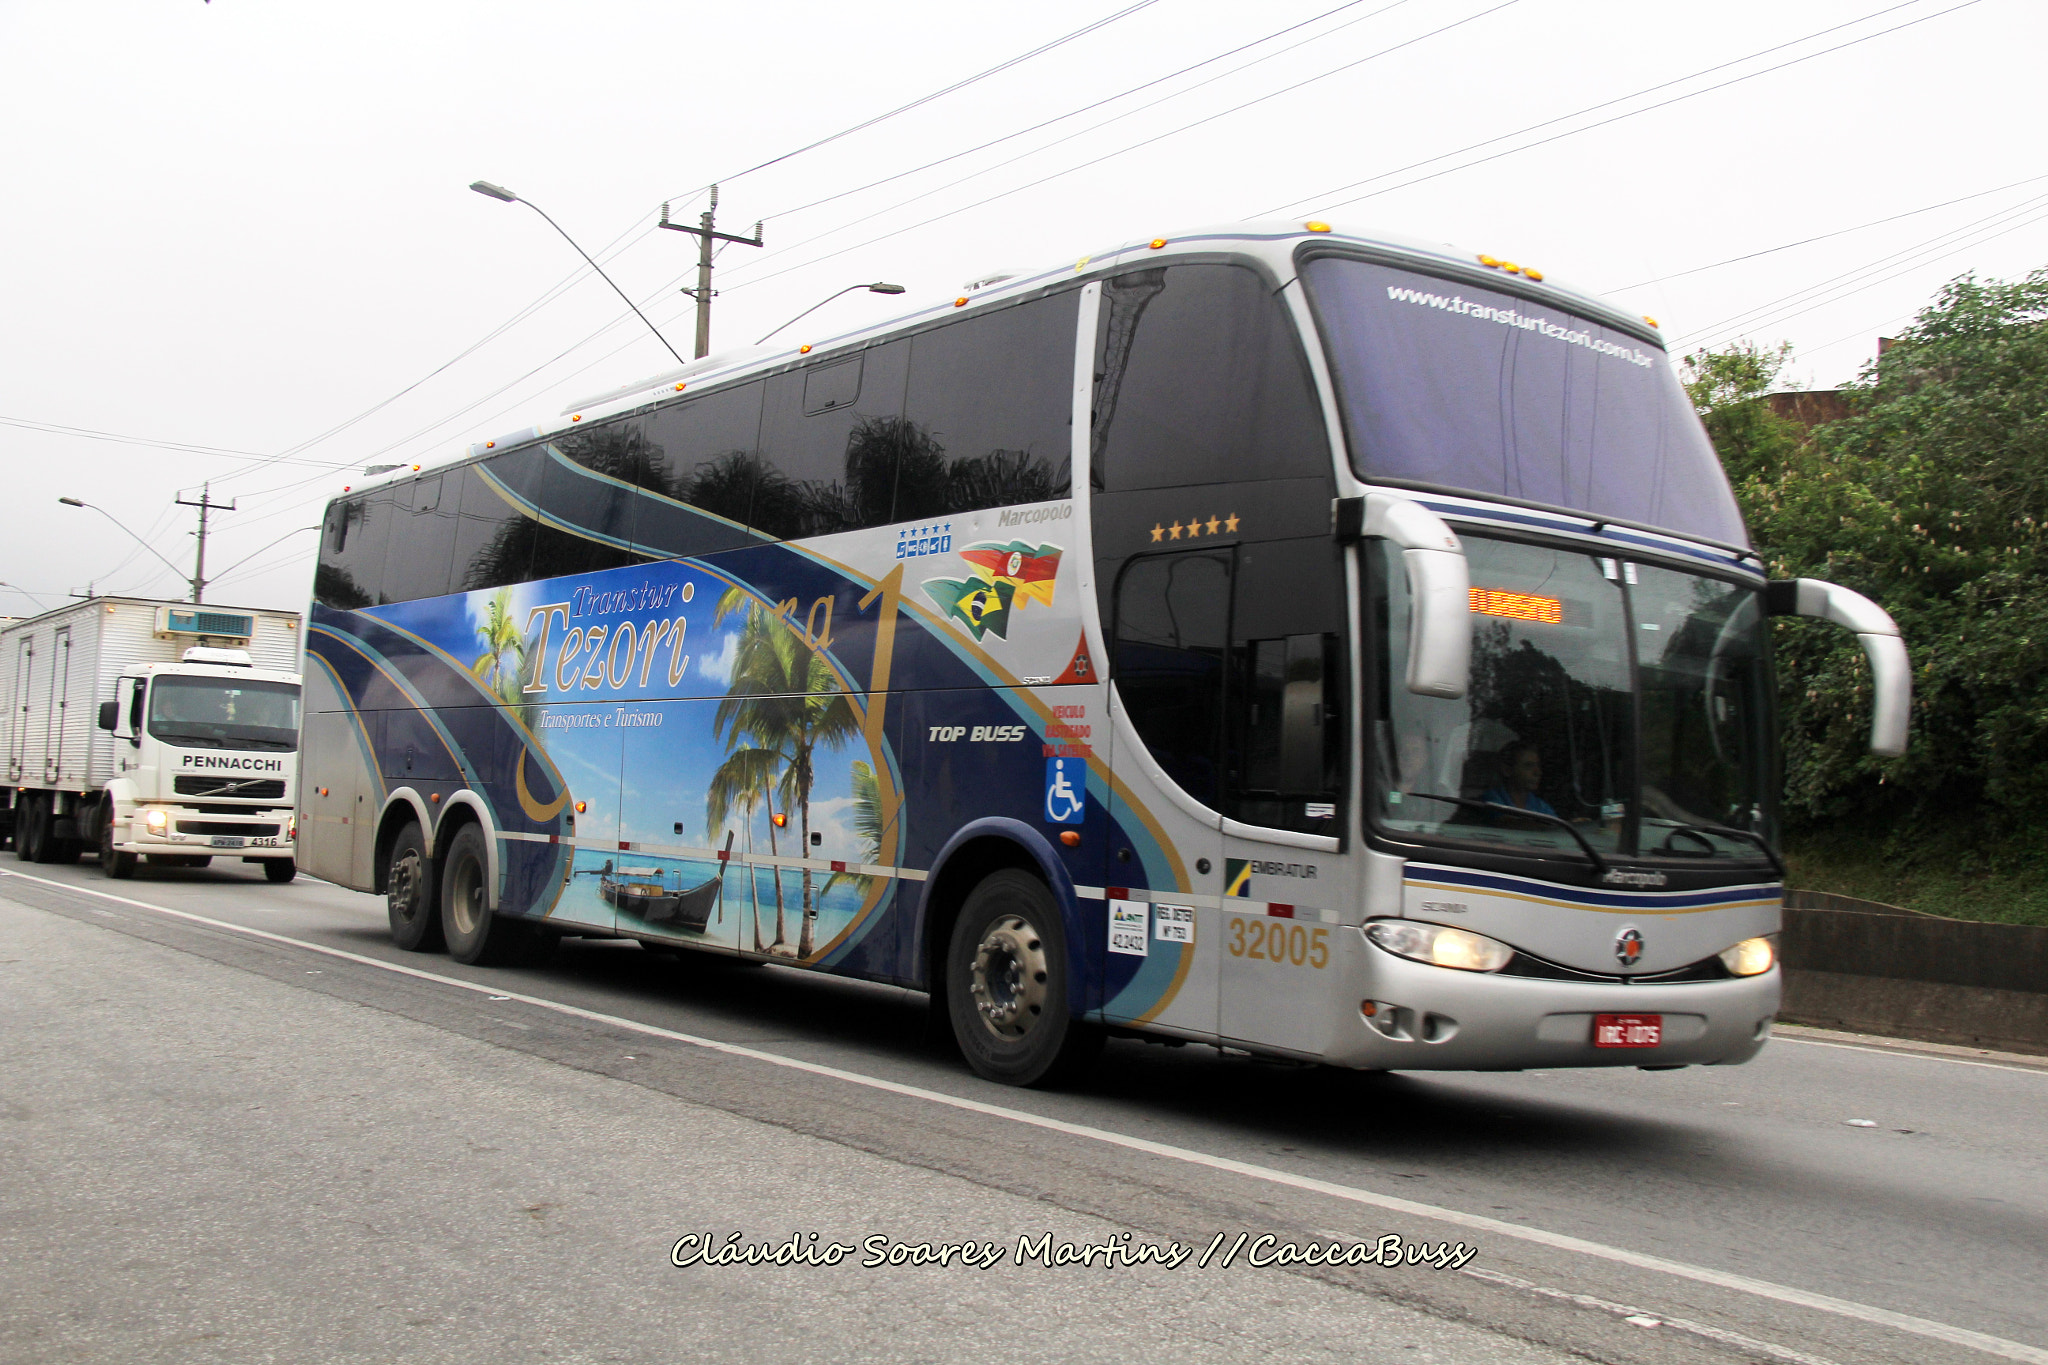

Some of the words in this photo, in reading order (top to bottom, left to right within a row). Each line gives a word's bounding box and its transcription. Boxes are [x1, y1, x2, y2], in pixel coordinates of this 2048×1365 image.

[1387, 285, 1653, 368] www.transturtezori.com.br
[998, 503, 1072, 528] Marcopolo
[572, 581, 678, 618] Transtur
[522, 581, 694, 694] Tezori
[540, 710, 601, 732] Transportes
[604, 713, 612, 728] e
[615, 708, 663, 728] Turismo
[929, 726, 966, 742] TOP
[970, 726, 1027, 742] BUSS
[182, 755, 282, 771] PENNACCHI
[251, 838, 278, 847] 4316
[1251, 860, 1318, 879] EMBRATUR
[1228, 917, 1330, 969] 32005
